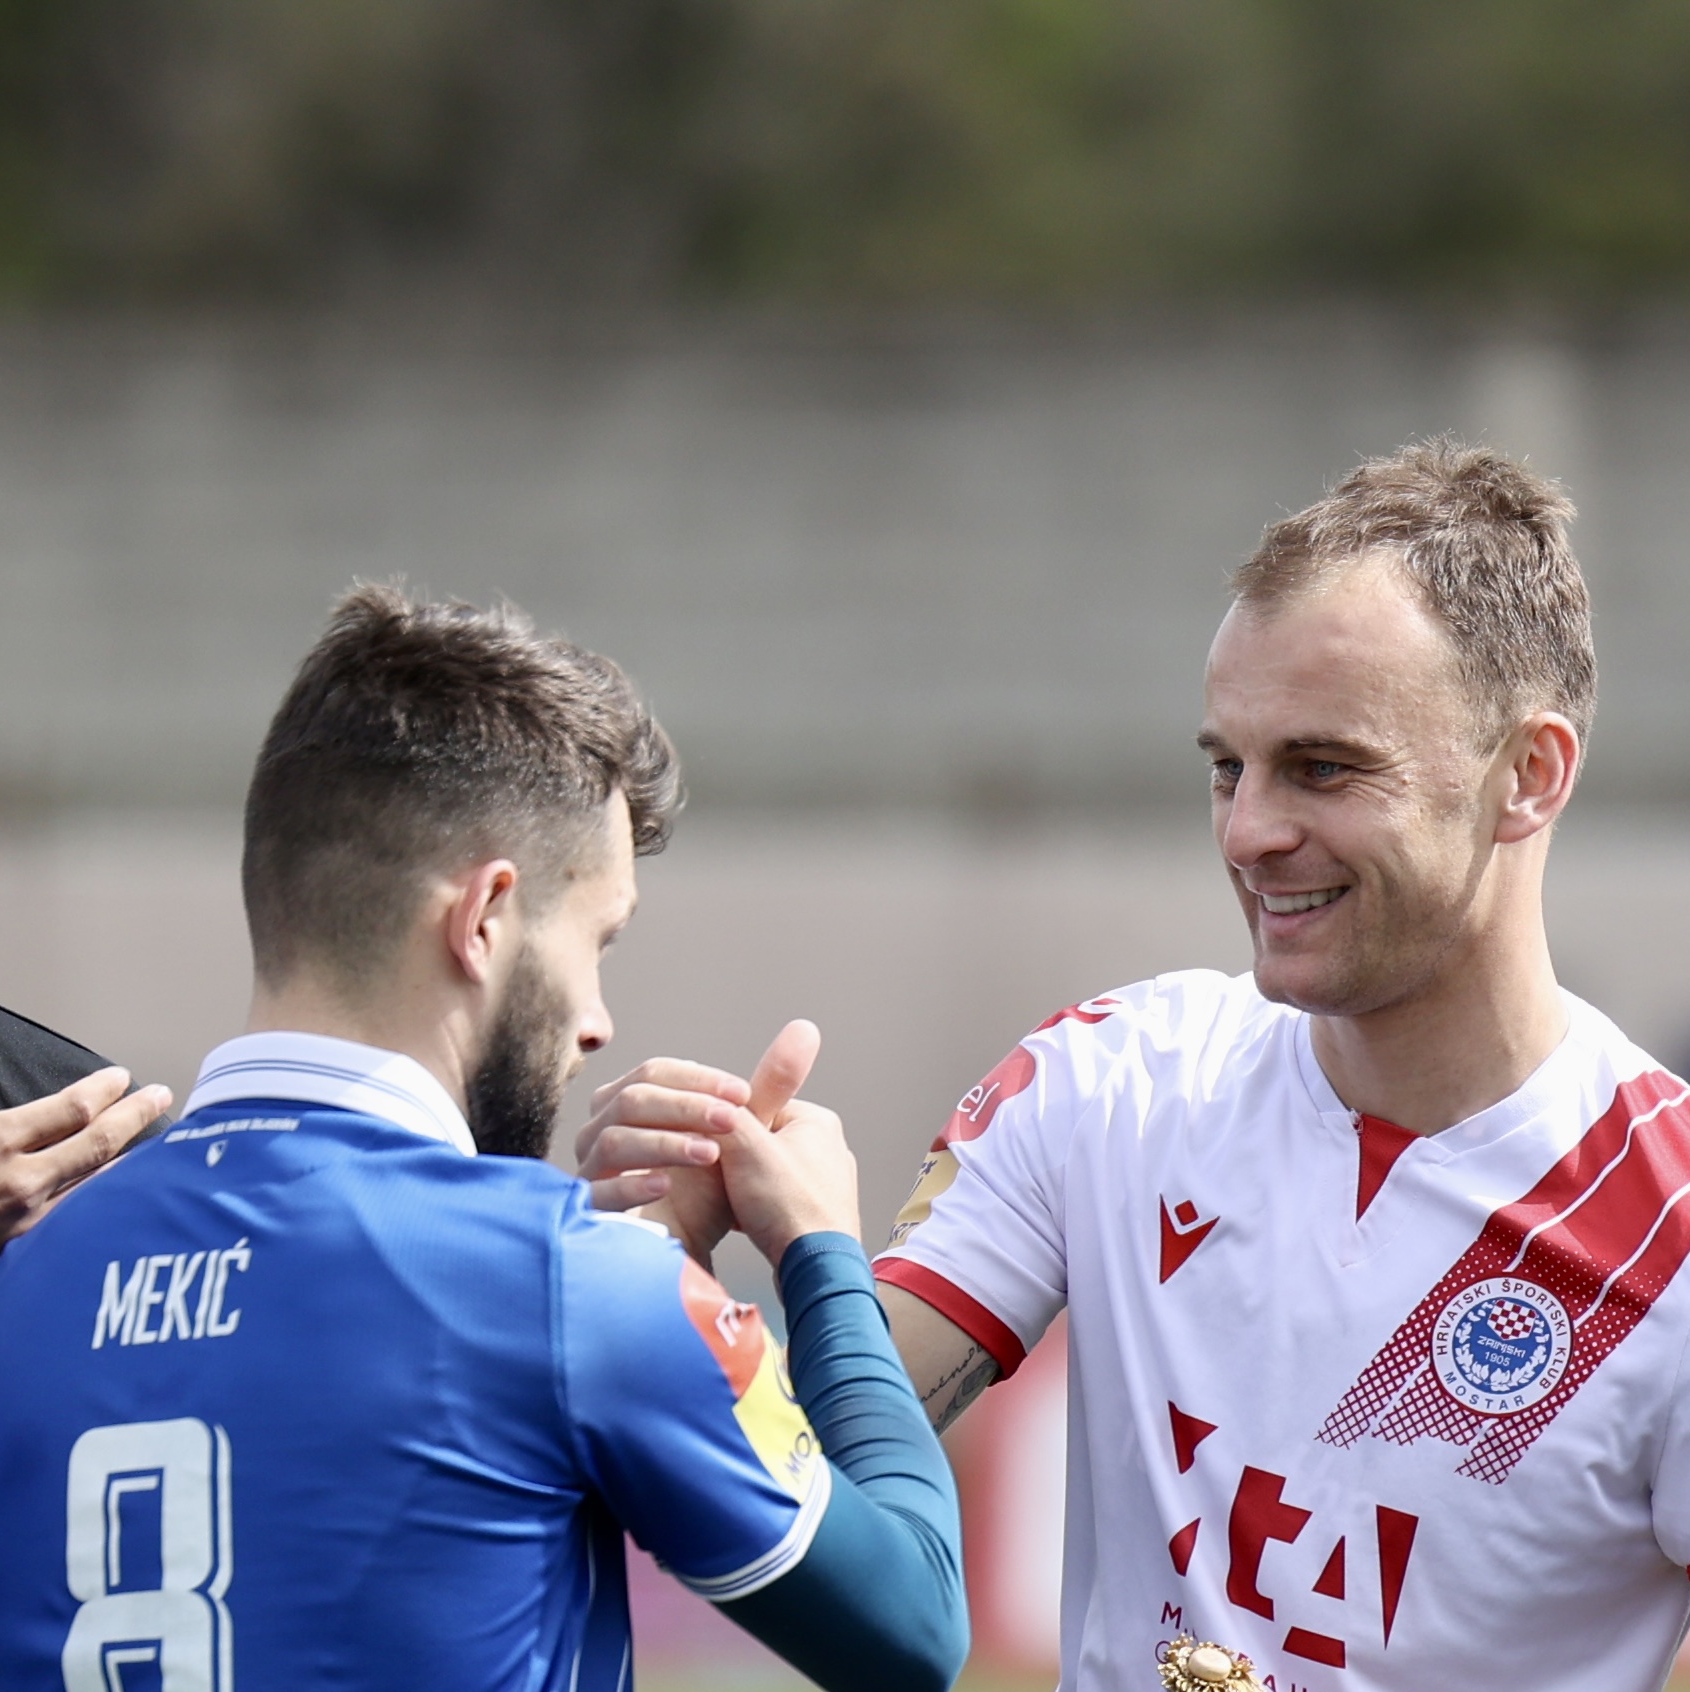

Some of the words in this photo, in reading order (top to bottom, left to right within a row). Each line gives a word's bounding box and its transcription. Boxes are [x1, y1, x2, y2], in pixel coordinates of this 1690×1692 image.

[91, 1236, 252, 1350] MEKIĆ
[1437, 1283, 1492, 1356] HRVATSKI
[1501, 1279, 1567, 1337] ŠPORTSKI
[1539, 1347, 1567, 1389] KLUB
[1484, 1352, 1510, 1367] 1905
[1443, 1371, 1525, 1411] MOSTAR
